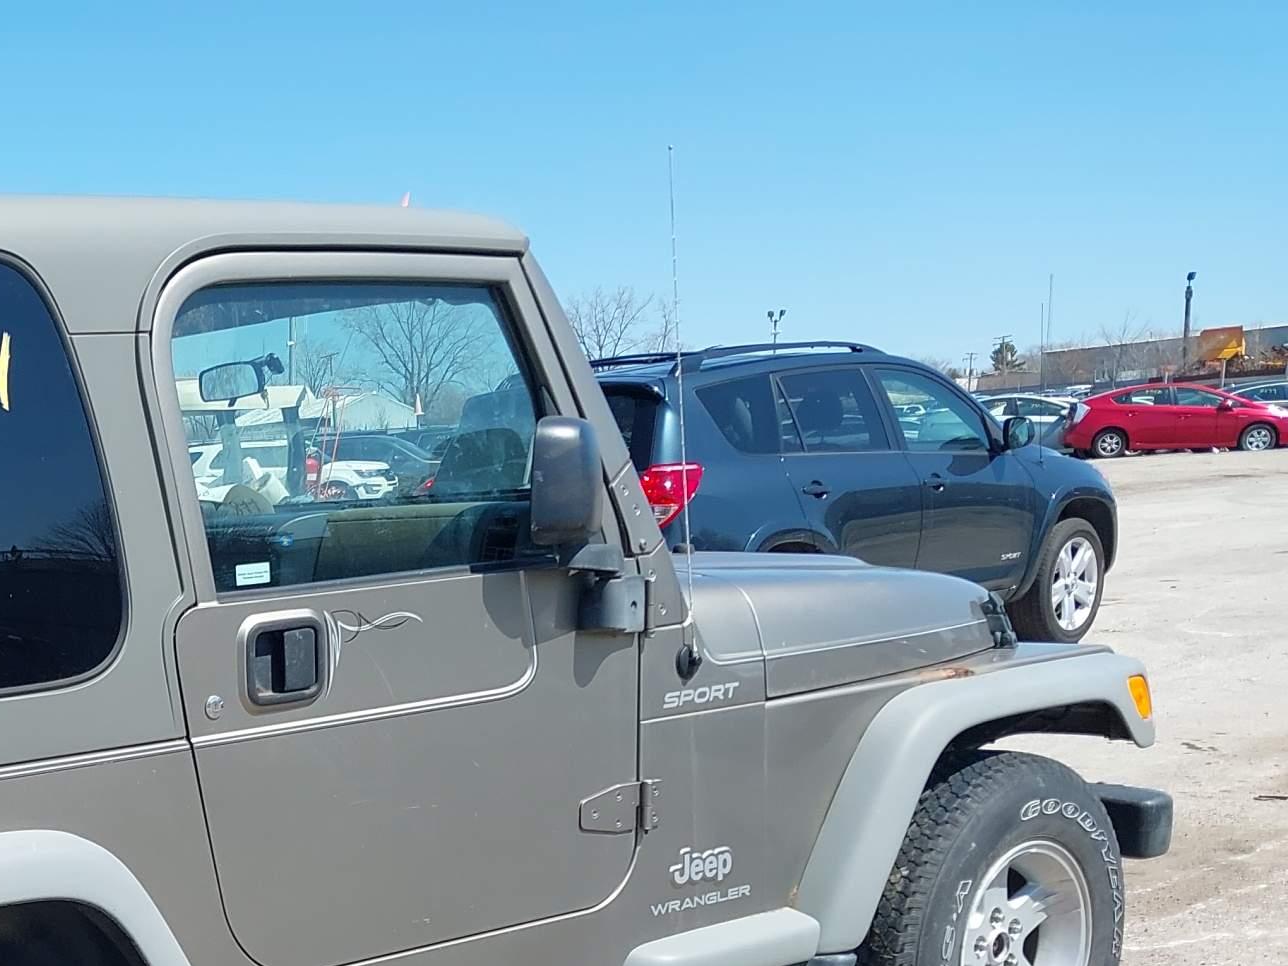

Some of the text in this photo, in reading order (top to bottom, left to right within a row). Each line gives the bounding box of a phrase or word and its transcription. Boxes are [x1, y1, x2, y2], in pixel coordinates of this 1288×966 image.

[1000, 551, 1023, 561] SPORT
[663, 681, 740, 709] SPORT
[668, 846, 732, 885] Jeep
[1020, 798, 1125, 958] GOODYEAR
[650, 884, 752, 917] WRANGLER
